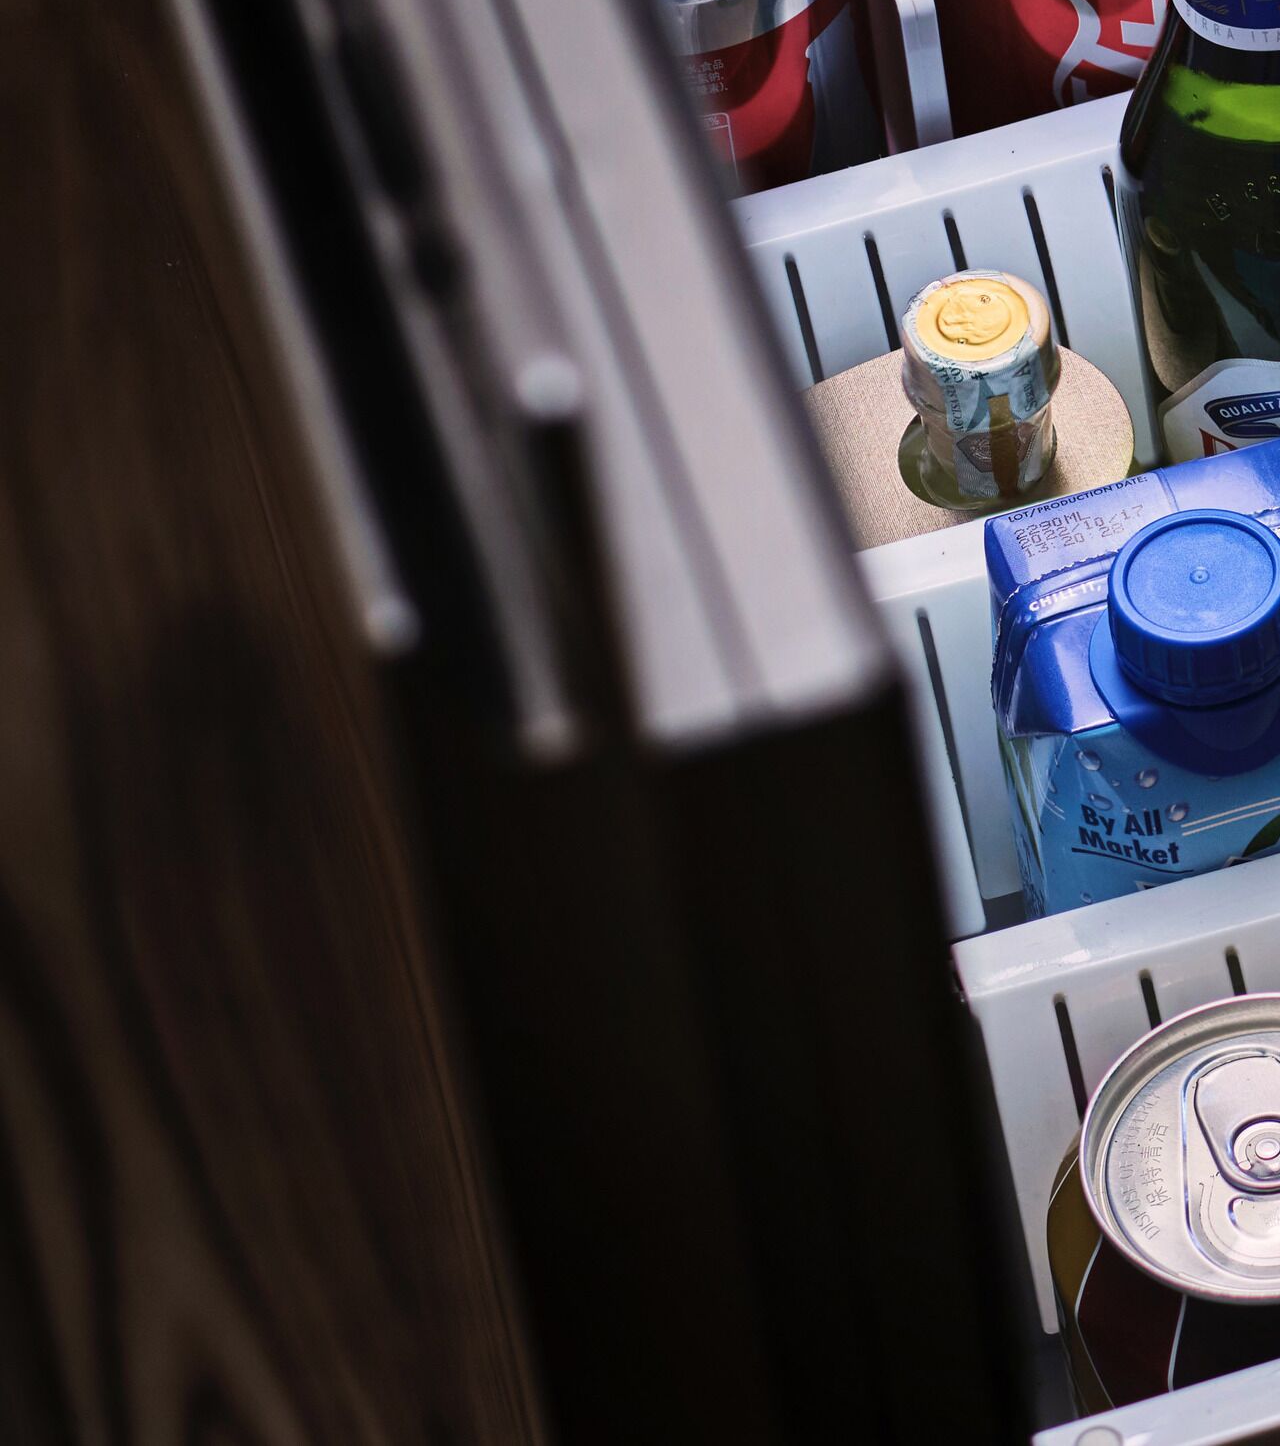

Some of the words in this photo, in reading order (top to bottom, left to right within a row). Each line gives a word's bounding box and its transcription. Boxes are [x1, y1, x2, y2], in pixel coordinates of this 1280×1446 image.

[1008, 486, 1112, 522] LOT/PRODUCTION
[1115, 476, 1148, 490] DATE:
[1018, 504, 1143, 549] 2022/10/17
[1029, 584, 1078, 612] CHILL
[1081, 805, 1114, 836] By
[1124, 810, 1163, 836] All
[1079, 827, 1179, 864] Market
[1140, 1122, 1169, 1207] 保持清洁
